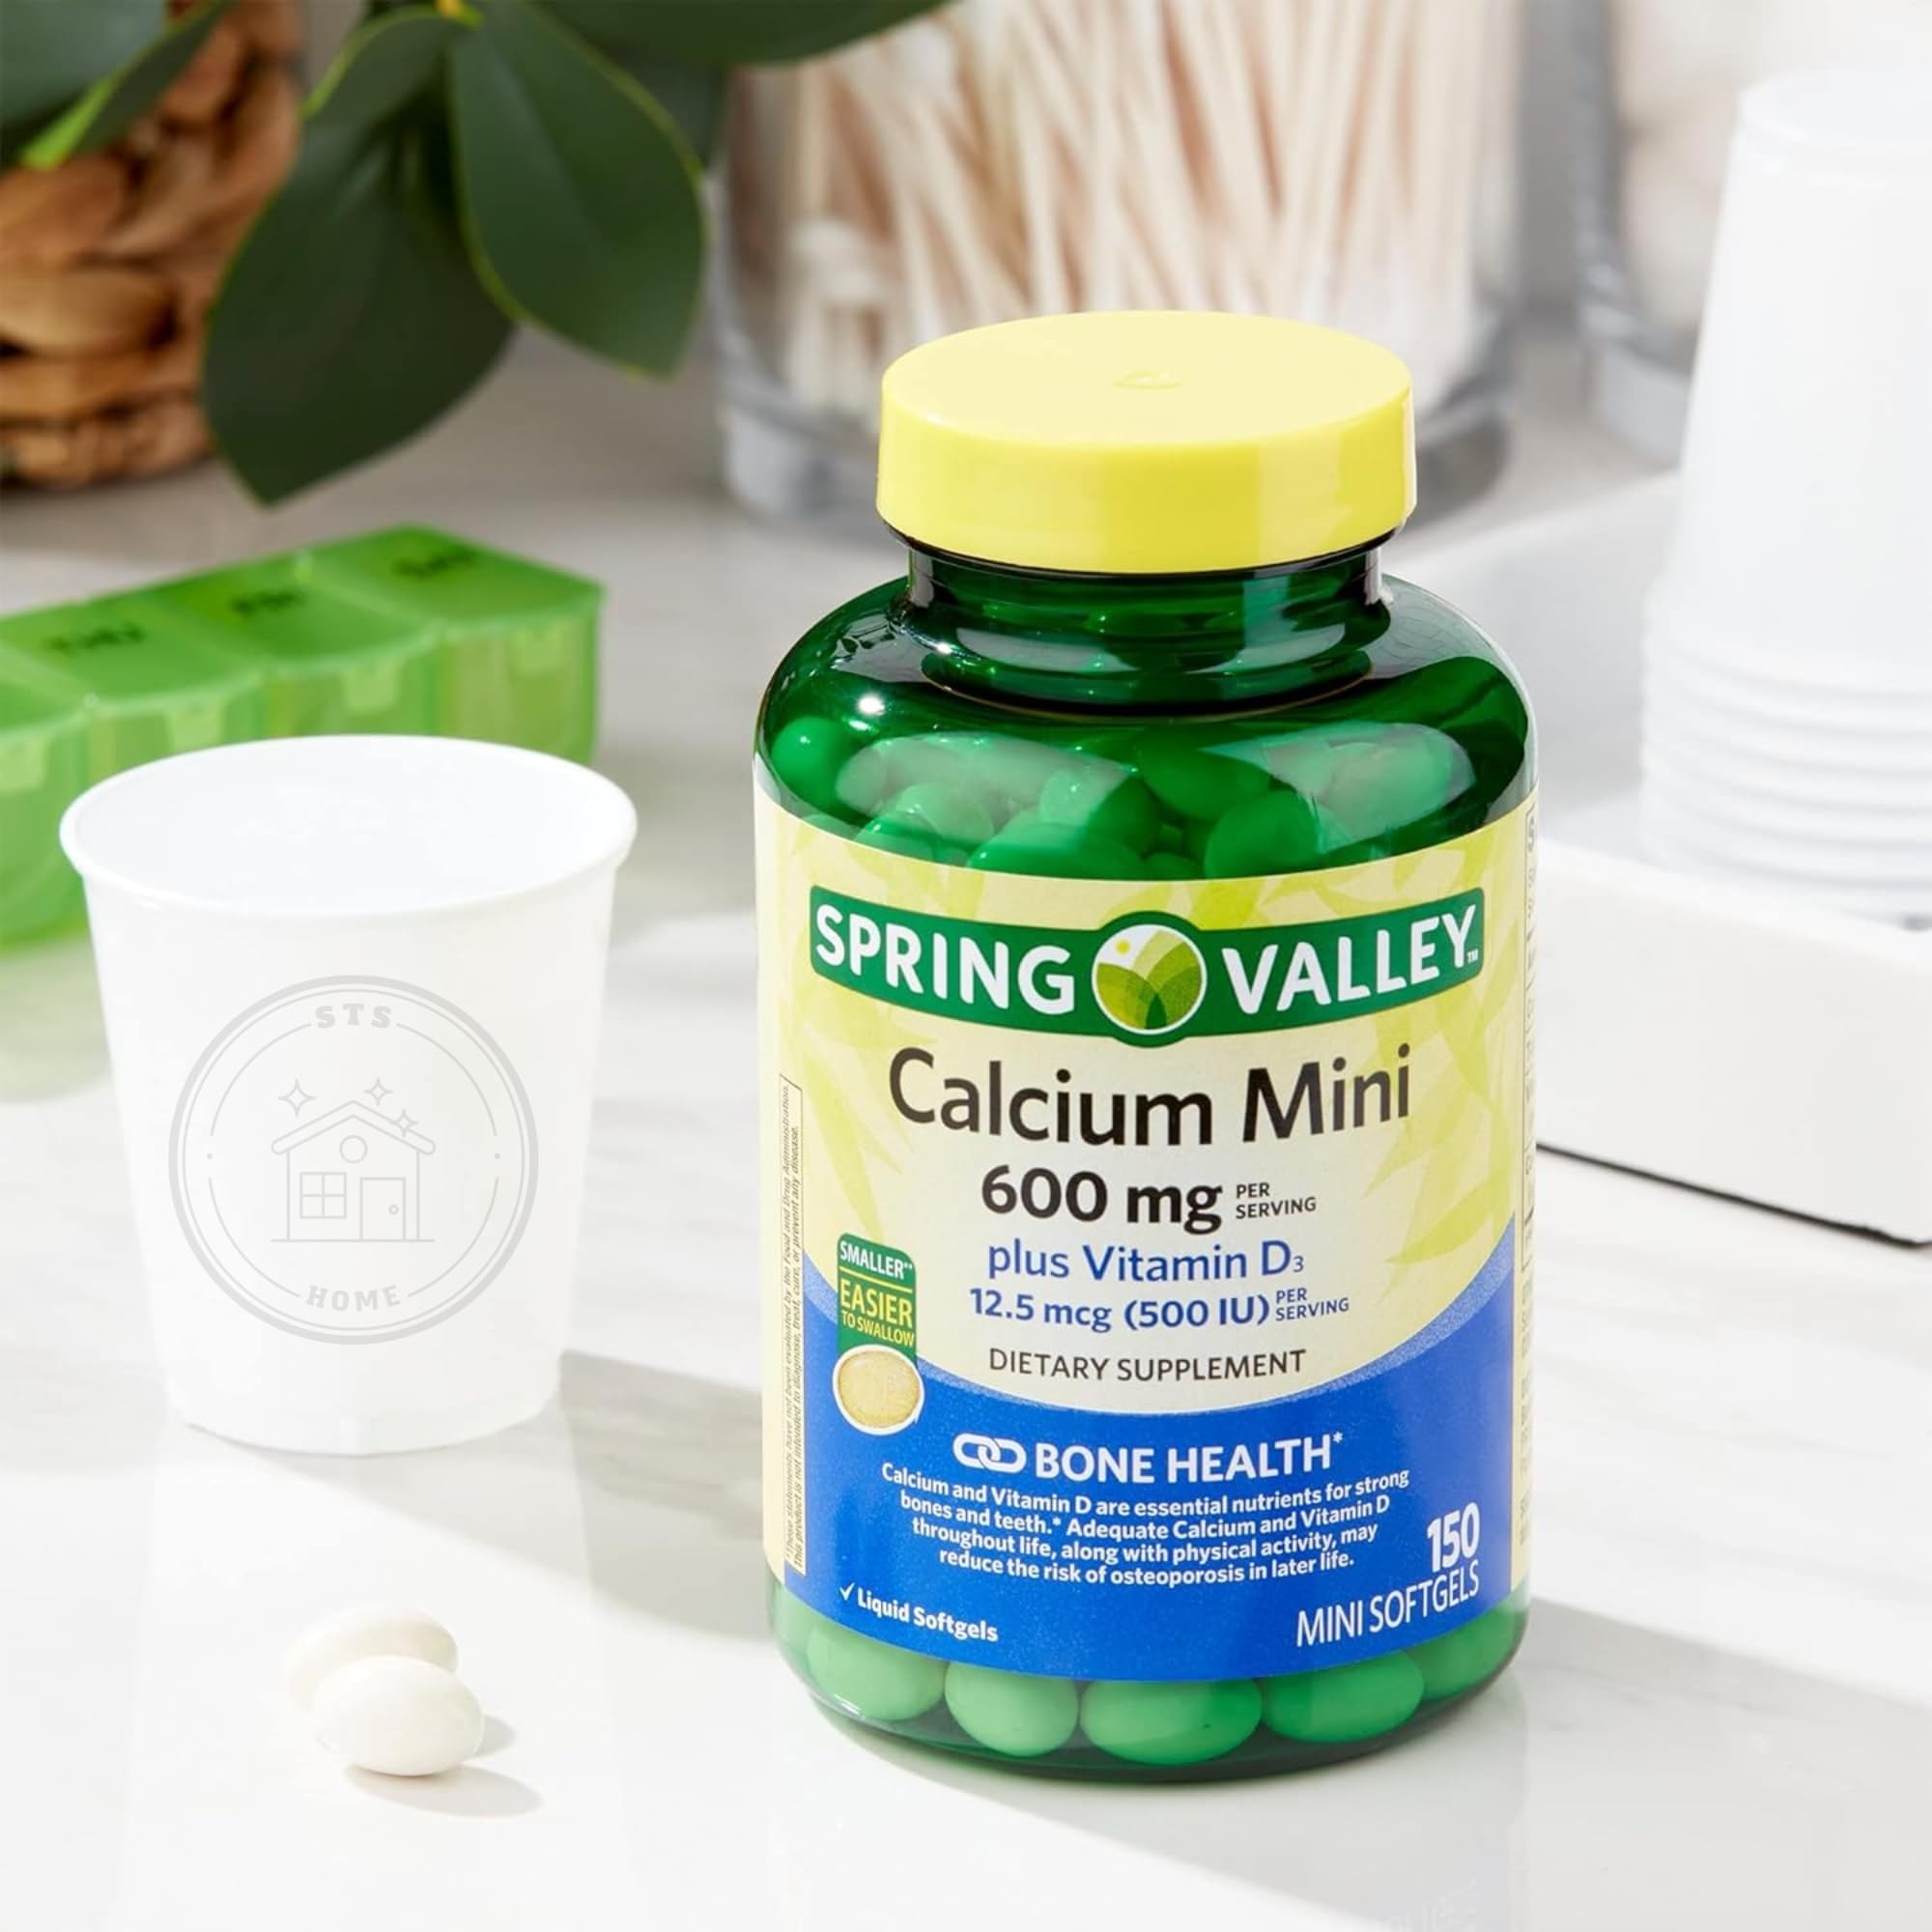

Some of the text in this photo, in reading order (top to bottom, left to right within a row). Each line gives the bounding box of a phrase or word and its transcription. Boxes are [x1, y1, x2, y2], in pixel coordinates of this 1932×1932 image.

[815, 903, 1074, 1014] SPRING
[1221, 904, 1477, 1014] VALLEY
[889, 1042, 1410, 1147] Calcium Mini
[781, 1178, 790, 1207] Drug
[791, 1177, 801, 1200] any
[981, 1164, 1223, 1236] 600 mg
[1236, 1181, 1270, 1200] PER
[1236, 1196, 1317, 1219] SERVING
[791, 1201, 801, 1248] prevent
[782, 1234, 791, 1264] Food
[793, 1249, 800, 1263] or
[988, 1237, 1070, 1280] plus
[1083, 1243, 1247, 1283] Vitamin
[782, 1265, 791, 1286] the
[783, 1288, 792, 1304] by
[839, 1277, 913, 1328] EASIER
[969, 1287, 1270, 1333] 12.5 mcg (500 IU)
[1275, 1287, 1308, 1304] PER
[1275, 1297, 1350, 1322] SERVING
[783, 1305, 792, 1364] evaluated
[840, 1310, 915, 1348] TO SWALLOW
[783, 1367, 792, 1396] been
[989, 1347, 1307, 1382] DIETARY SUPPLEMENT
[783, 1397, 792, 1418] not
[792, 1391, 801, 1404] to
[783, 1420, 793, 1450] have
[793, 1406, 802, 1458] intended
[793, 1459, 802, 1480] not
[1035, 1441, 1155, 1484] BONE
[784, 1453, 794, 1517] statements
[793, 1482, 803, 1493] is
[881, 1462, 1410, 1517] Calcium and Vitamin D are essential nutrients for strong
[794, 1493, 804, 1543] product
[900, 1490, 952, 1520] bones
[955, 1505, 990, 1526] and
[1066, 1518, 1169, 1542] Adequate
[1173, 1518, 1255, 1540] Calcium
[1260, 1512, 1296, 1533] and
[1300, 1500, 1373, 1528] Vitamin
[1376, 1494, 1390, 1514] D
[794, 1543, 803, 1568] This
[912, 1518, 1378, 1566] throughout life, along with physical activity, may
[1427, 1501, 1481, 1573] 150
[939, 1548, 1354, 1588] reduce the risk of osteoporosis in later life.
[857, 1587, 999, 1642] Liquid Softgels
[1296, 1559, 1480, 1648] MINI SOFTGELS
